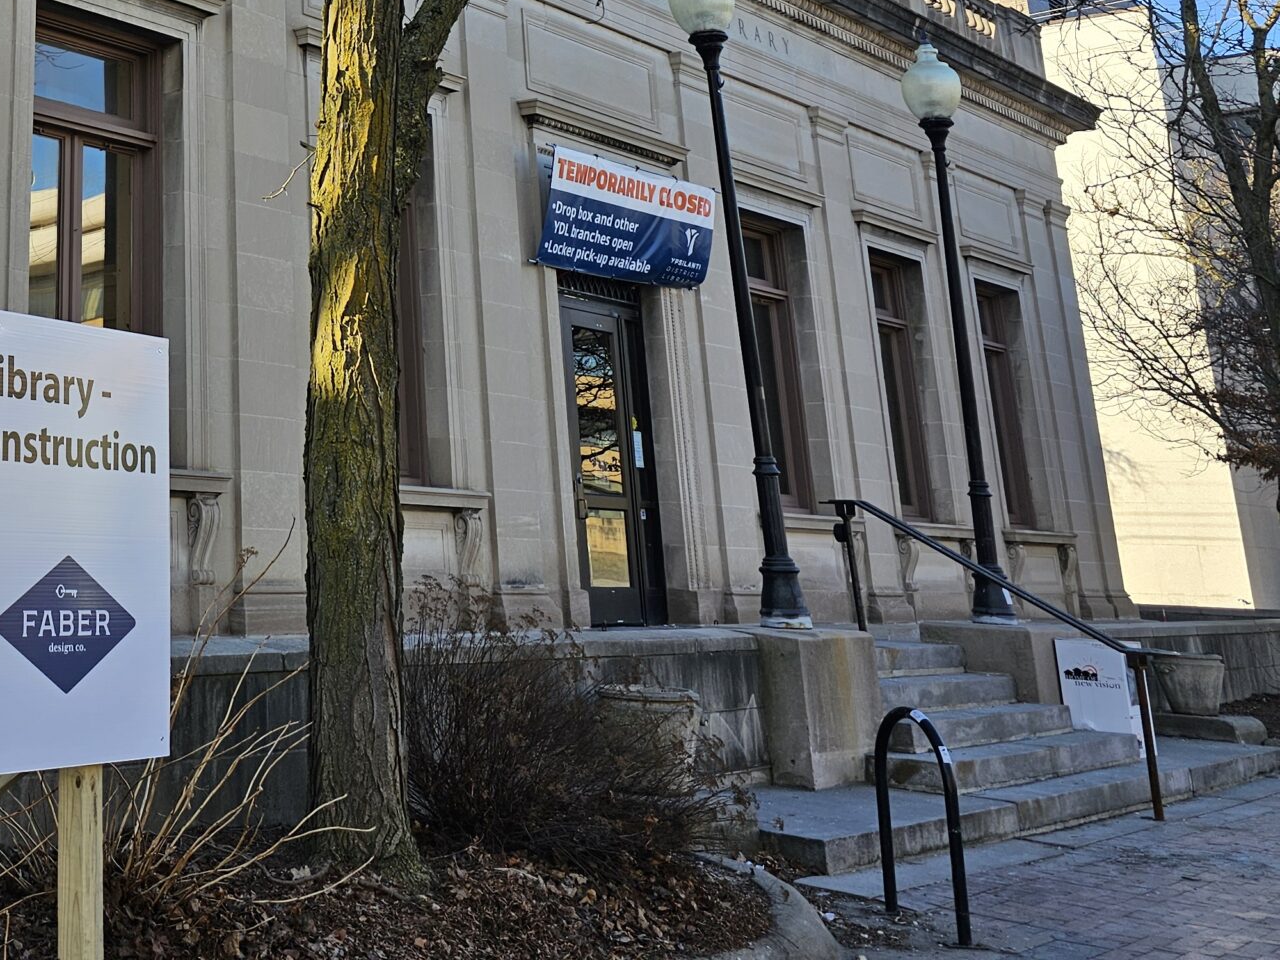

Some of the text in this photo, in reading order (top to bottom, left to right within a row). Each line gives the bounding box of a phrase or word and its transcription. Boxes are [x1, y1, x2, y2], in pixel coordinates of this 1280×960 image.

[557, 157, 712, 219] TEMPORARILY CLOSED
[555, 200, 640, 234] Drop box and other
[553, 220, 634, 255] YDL branches open
[548, 239, 651, 275] Locker pick-up available
[665, 265, 699, 278] DISTRICT
[670, 257, 702, 270] YPSILANTI
[21, 608, 112, 638] FABER
[48, 640, 87, 656] design co.
